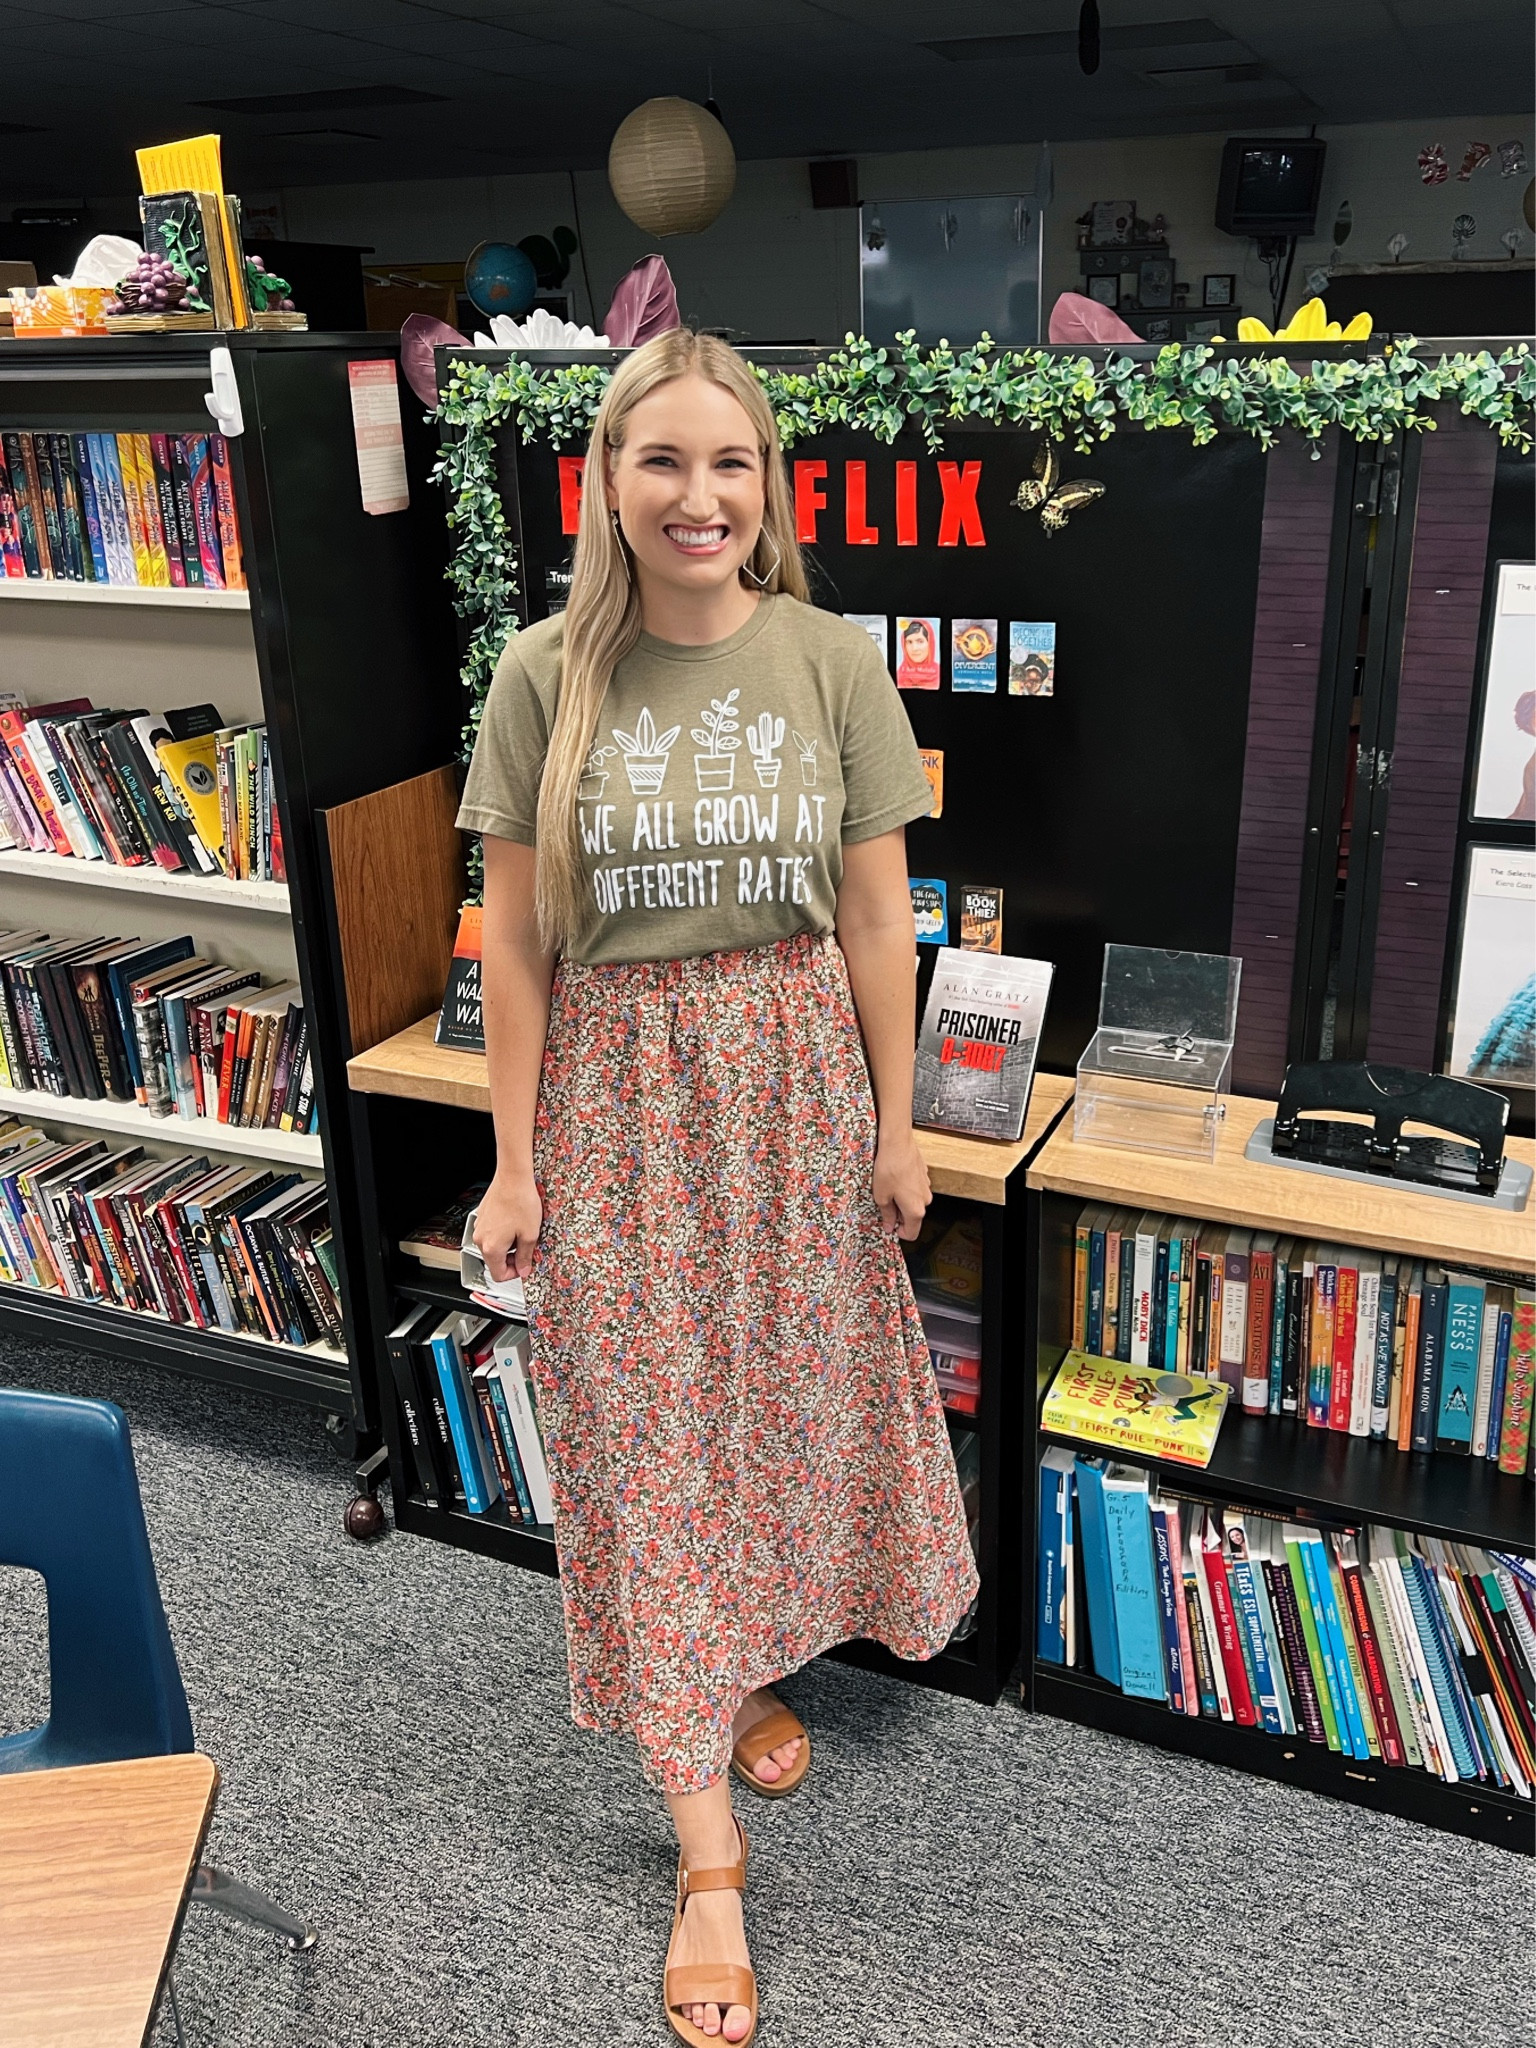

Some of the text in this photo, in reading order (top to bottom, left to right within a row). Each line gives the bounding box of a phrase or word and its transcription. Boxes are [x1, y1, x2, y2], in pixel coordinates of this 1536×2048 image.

[175, 440, 183, 464] COLFER
[81, 477, 94, 517] ARTEMIS
[163, 480, 179, 547] ARTEMIS FOWL
[181, 480, 196, 547] ARTEMIS FOWL
[200, 480, 214, 547] ARTEMIS FOWL
[164, 512, 172, 544] DECEPTION
[550, 571, 574, 583] Tren
[1012, 637, 1053, 648] TOGETHER
[954, 662, 995, 670] DIVERGENT
[126, 730, 137, 745] CRAFT
[48, 771, 69, 802] elixir
[119, 763, 150, 817] As Old as Time
[151, 783, 177, 823] NEW KID
[174, 785, 196, 822] GHOST
[579, 794, 826, 855] WE ALL GROW AT
[593, 859, 724, 914] DIFFERENT
[966, 894, 996, 910] BOOK
[966, 906, 996, 918] THIEF
[466, 962, 478, 979] A
[456, 981, 482, 1001] WAL
[943, 983, 979, 997] ALAN
[985, 989, 1030, 1004] GRATZ
[2, 1023, 17, 1063] RUNNER
[14, 998, 35, 1065] SCORCH TRIALS
[24, 999, 46, 1067] SCORCH TRIALS
[32, 1002, 52, 1062] DEATH CURE
[197, 1021, 206, 1051] FRANK
[204, 1025, 212, 1049] ANNE
[936, 1008, 1021, 1046] PRISONER
[91, 1032, 112, 1078] DEEPER
[292, 1022, 307, 1076] ANOTHER TIME
[940, 1037, 1006, 1073] B-3087
[221, 1059, 230, 1089] FEVER
[271, 1090, 280, 1112] PLACES
[297, 1095, 310, 1115] STAR
[6, 1220, 33, 1276] AUDITION
[183, 1235, 206, 1282] ILLEGAL
[232, 1246, 246, 1269] HOUSE
[243, 1223, 271, 1285] OCTAVIA BUTLER
[220, 1262, 232, 1282] BLOOD
[226, 1282, 237, 1298] ROAD
[1254, 1263, 1270, 1280] Avi
[1316, 1269, 1326, 1308] Teenage Soul
[1325, 1270, 1334, 1293] Chicken
[1369, 1277, 1378, 1301] Chicken
[290, 1266, 327, 1334] GRACE FURY
[305, 1269, 346, 1341] QUEEN RUIN
[1167, 1294, 1176, 1327] Am Malala
[1226, 1286, 1234, 1316] GIRLS
[1234, 1287, 1243, 1316] LILAC
[1254, 1286, 1263, 1307] THE
[1324, 1294, 1332, 1309] Soup
[1337, 1294, 1345, 1307] Soup
[1344, 1287, 1353, 1307] Helping
[1360, 1277, 1370, 1317] Teenage Soul
[1367, 1303, 1376, 1318] Soup
[1138, 1291, 1150, 1342] MOBY DICK
[1367, 1319, 1375, 1328] for
[1448, 1302, 1469, 1350] NESS
[1463, 1304, 1477, 1351] PATRICK
[1375, 1311, 1389, 1404] NOT AS WE KNOW IT
[1420, 1333, 1433, 1412] ALABAMA MOON
[1068, 1363, 1096, 1399] FIRST
[1088, 1376, 1116, 1407] RULE
[1113, 1374, 1138, 1409] PUNK
[1509, 1352, 1529, 1427] Hello, Sunshine
[403, 1400, 420, 1446] collections
[432, 1397, 447, 1443] collections
[1086, 1423, 1184, 1453] FIRST RULE PUNK
[1109, 1506, 1135, 1519] Daily
[1154, 1526, 1173, 1617] Lessons That Change Writers
[1116, 1584, 1149, 1599] Editing
[1211, 1580, 1236, 1651] Grammar for Writing
[1234, 1566, 1267, 1662] TExES ESL SUPPLEMENTAL
[1349, 1574, 1368, 1632] COMPREHENSION
[1363, 1639, 1382, 1694] COLLABORATION
[1322, 1654, 1334, 1676] Spelling
[1346, 1644, 1371, 1720] REVIVING ESSAY
[1336, 1658, 1357, 1714] Vocabulary Workshop
